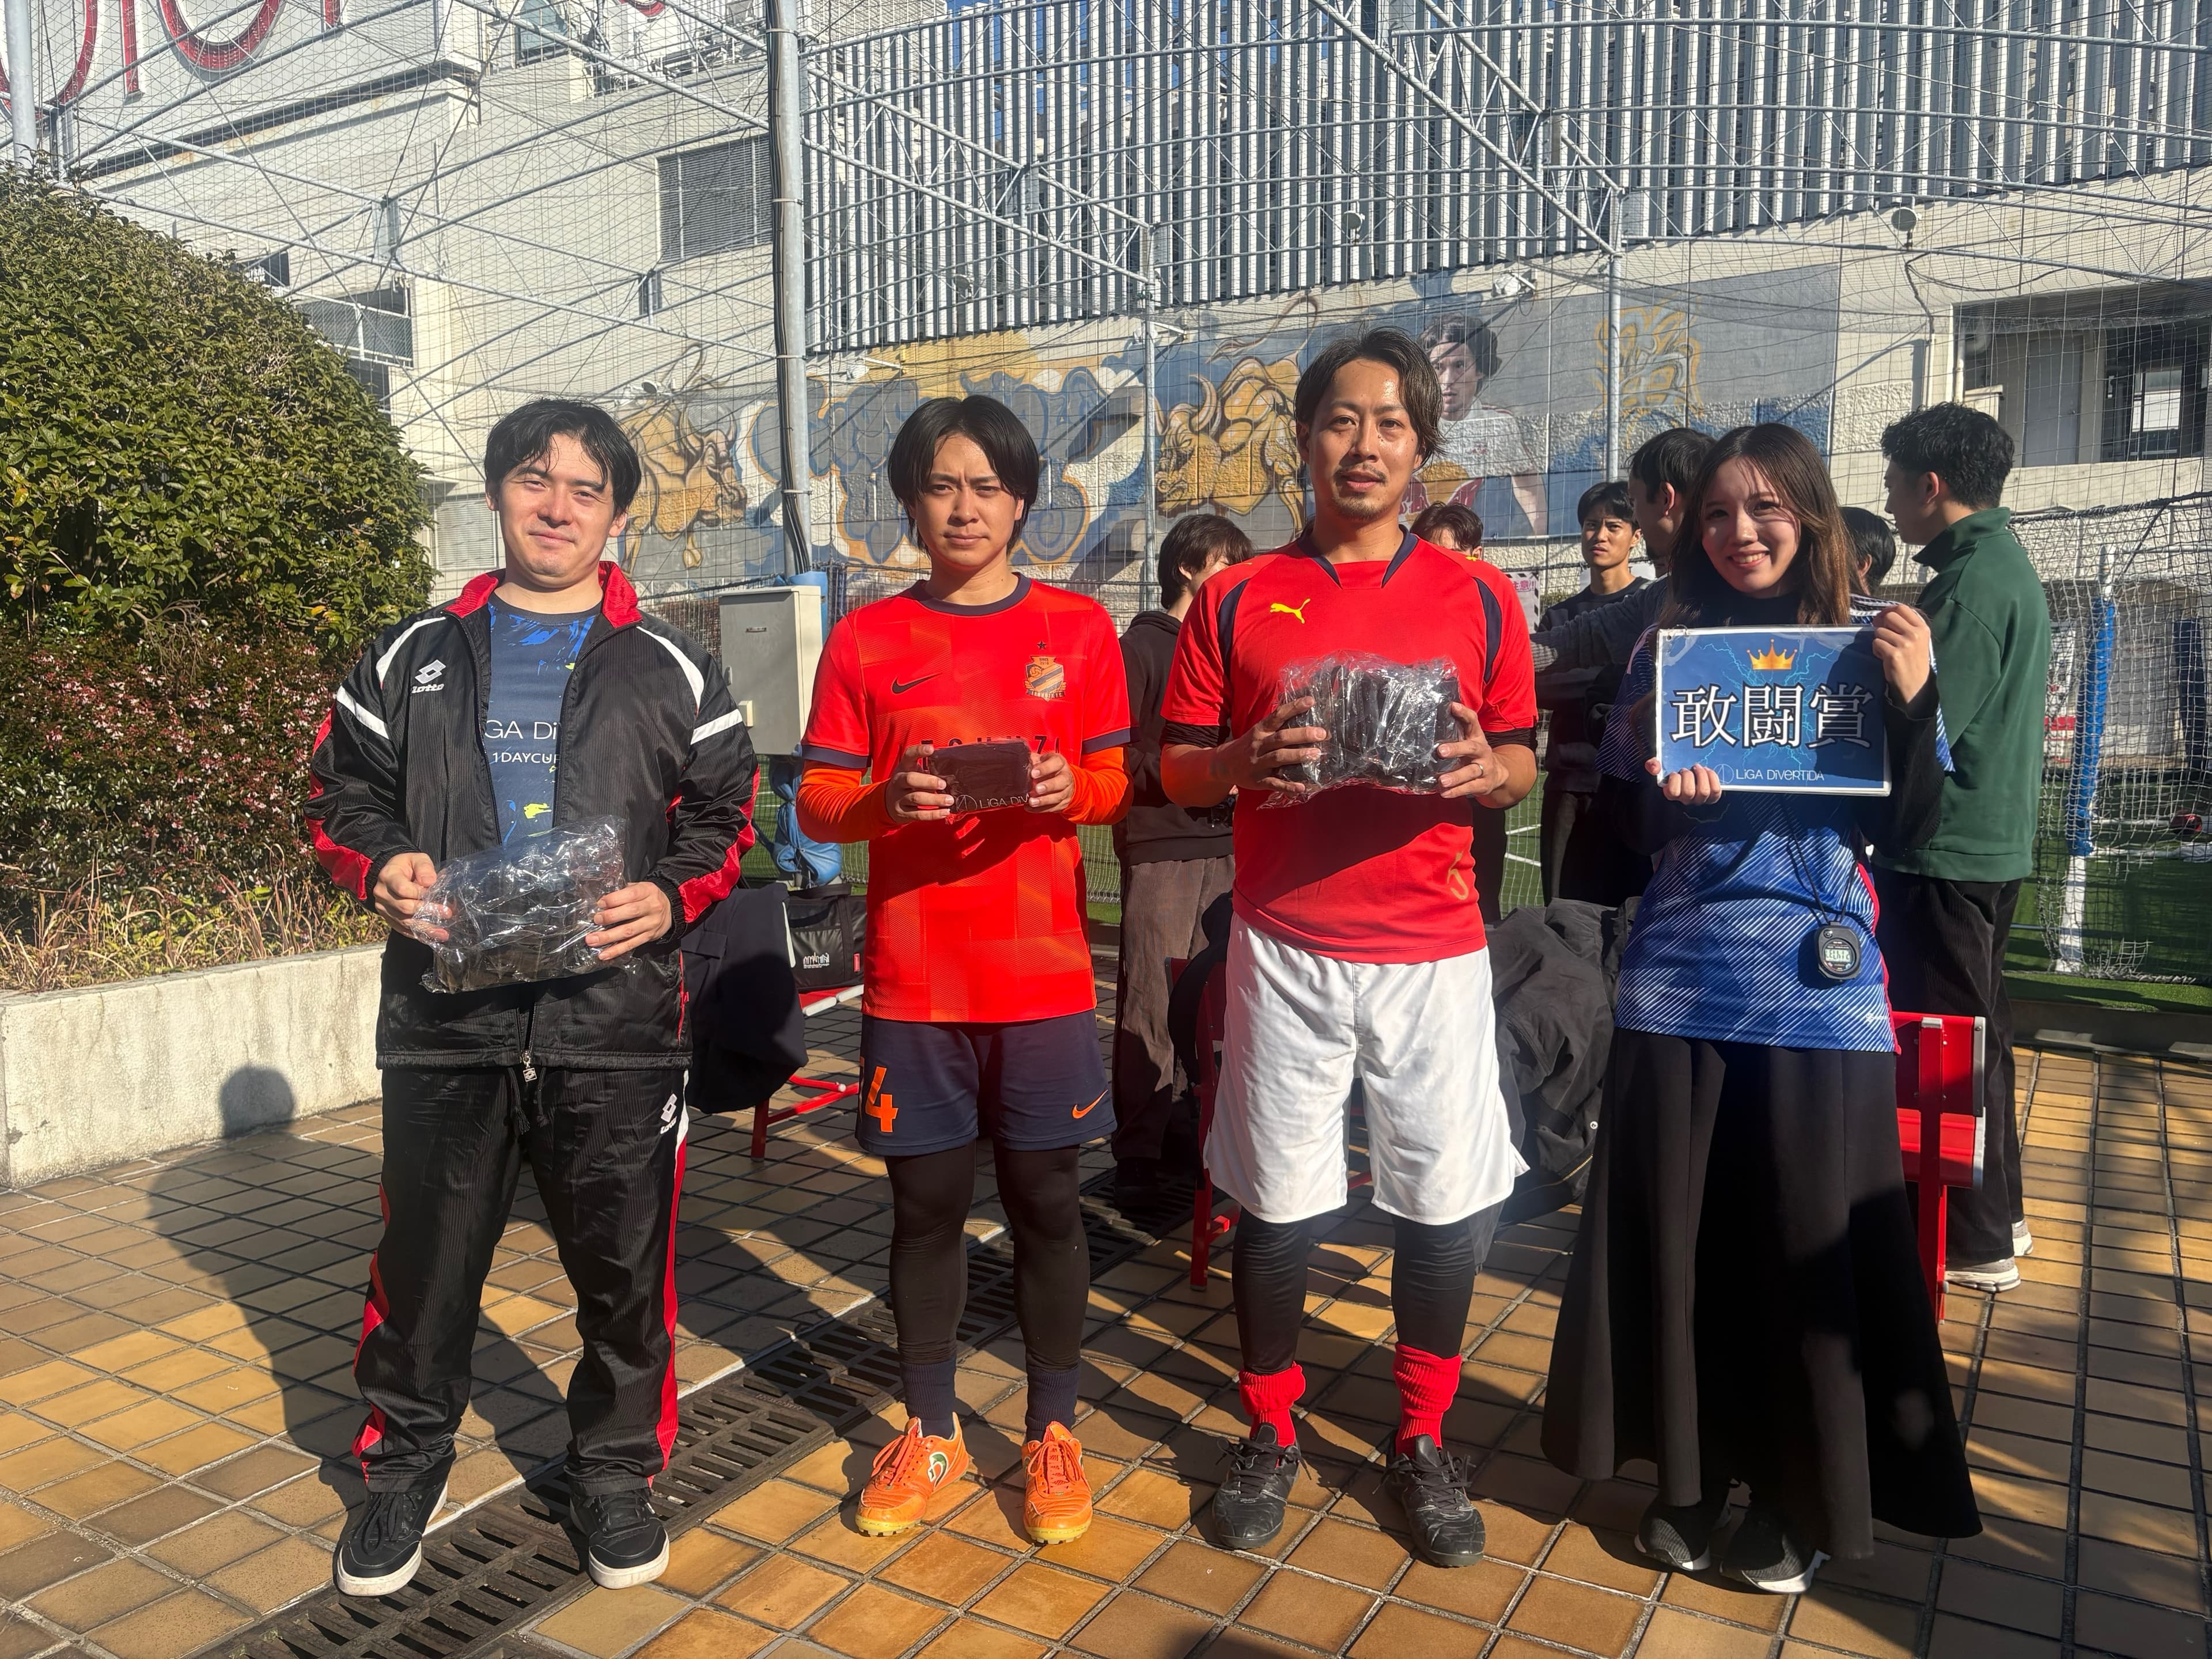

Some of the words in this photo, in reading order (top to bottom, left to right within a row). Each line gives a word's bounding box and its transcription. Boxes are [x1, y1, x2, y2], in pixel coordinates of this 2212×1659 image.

[411, 684, 445, 694] lotto
[1669, 681, 1874, 749] 敢闘賞
[865, 1066, 899, 1132] 4
